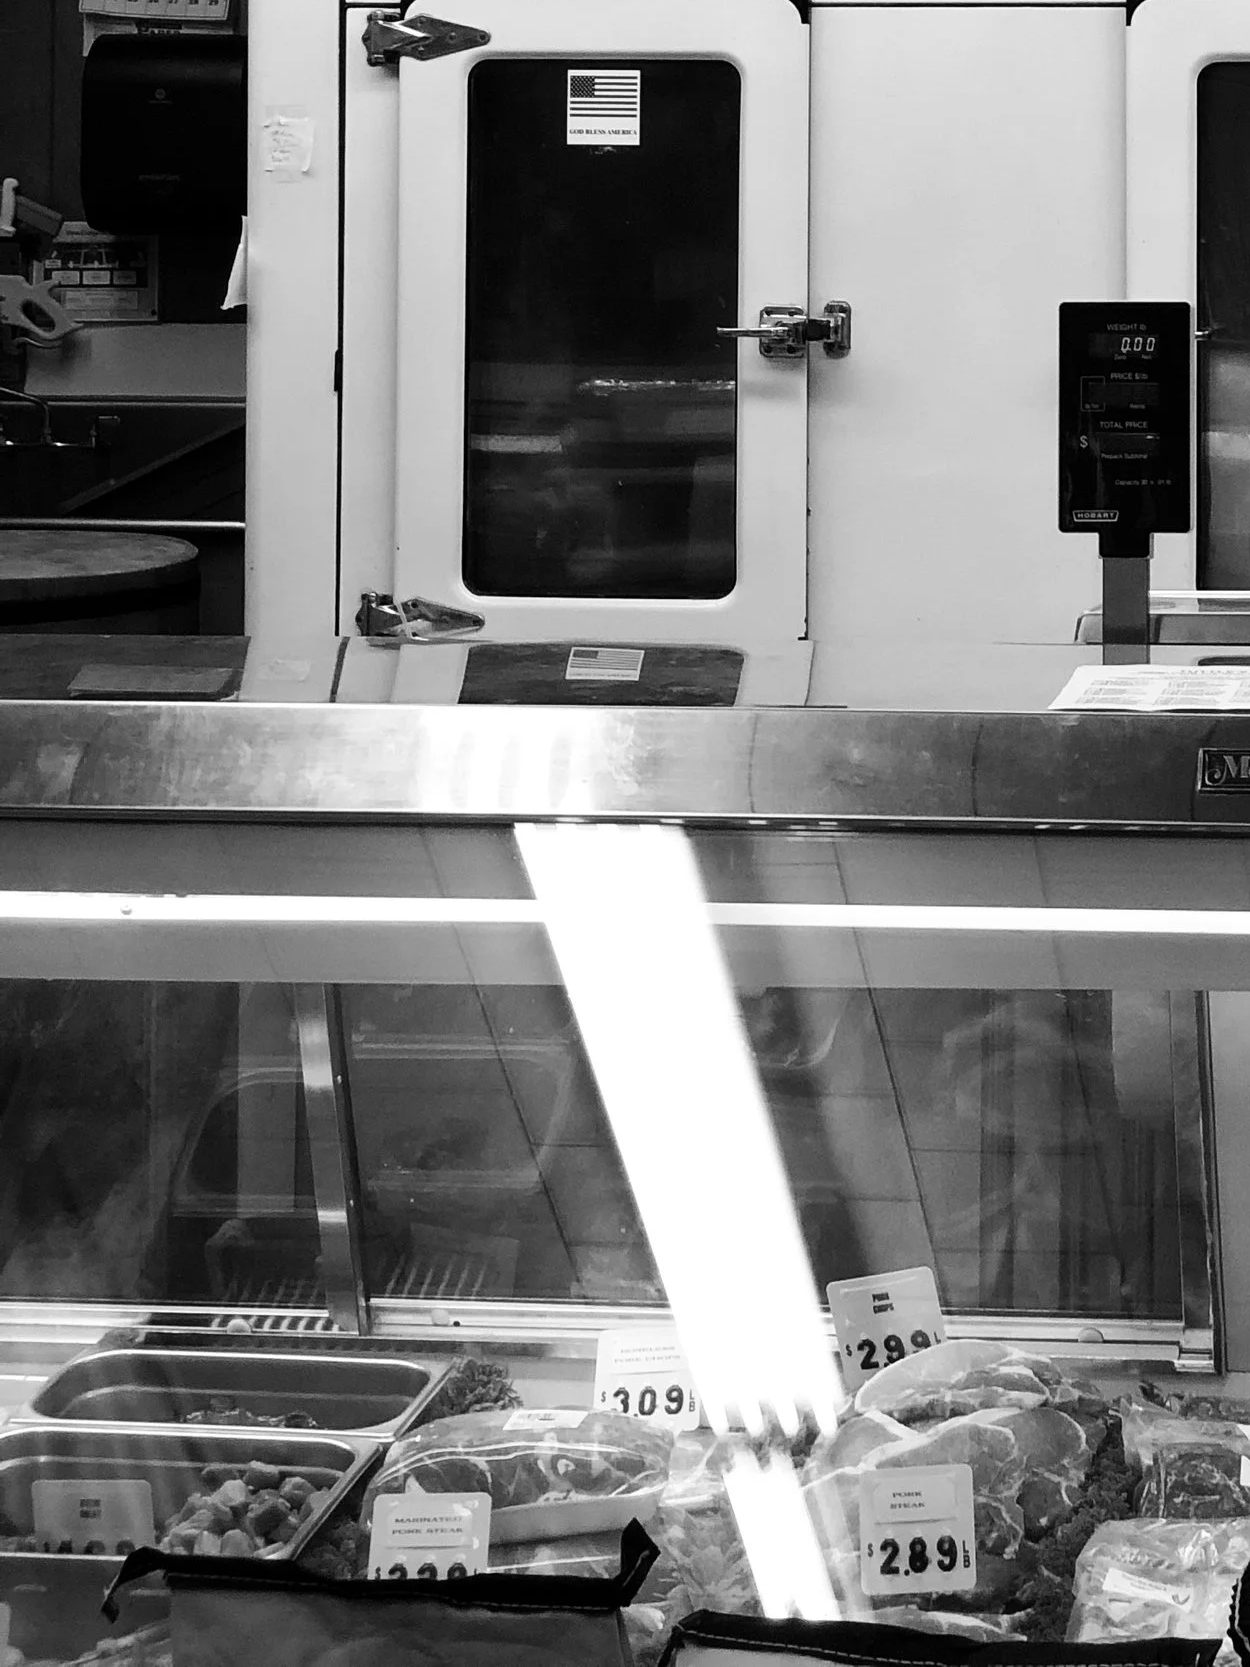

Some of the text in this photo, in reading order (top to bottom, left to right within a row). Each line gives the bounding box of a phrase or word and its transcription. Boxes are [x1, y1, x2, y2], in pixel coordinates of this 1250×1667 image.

[1107, 323, 1138, 331] WEIGHT
[1121, 337, 1155, 352] 0.00
[1110, 372, 1132, 380] PRICE
